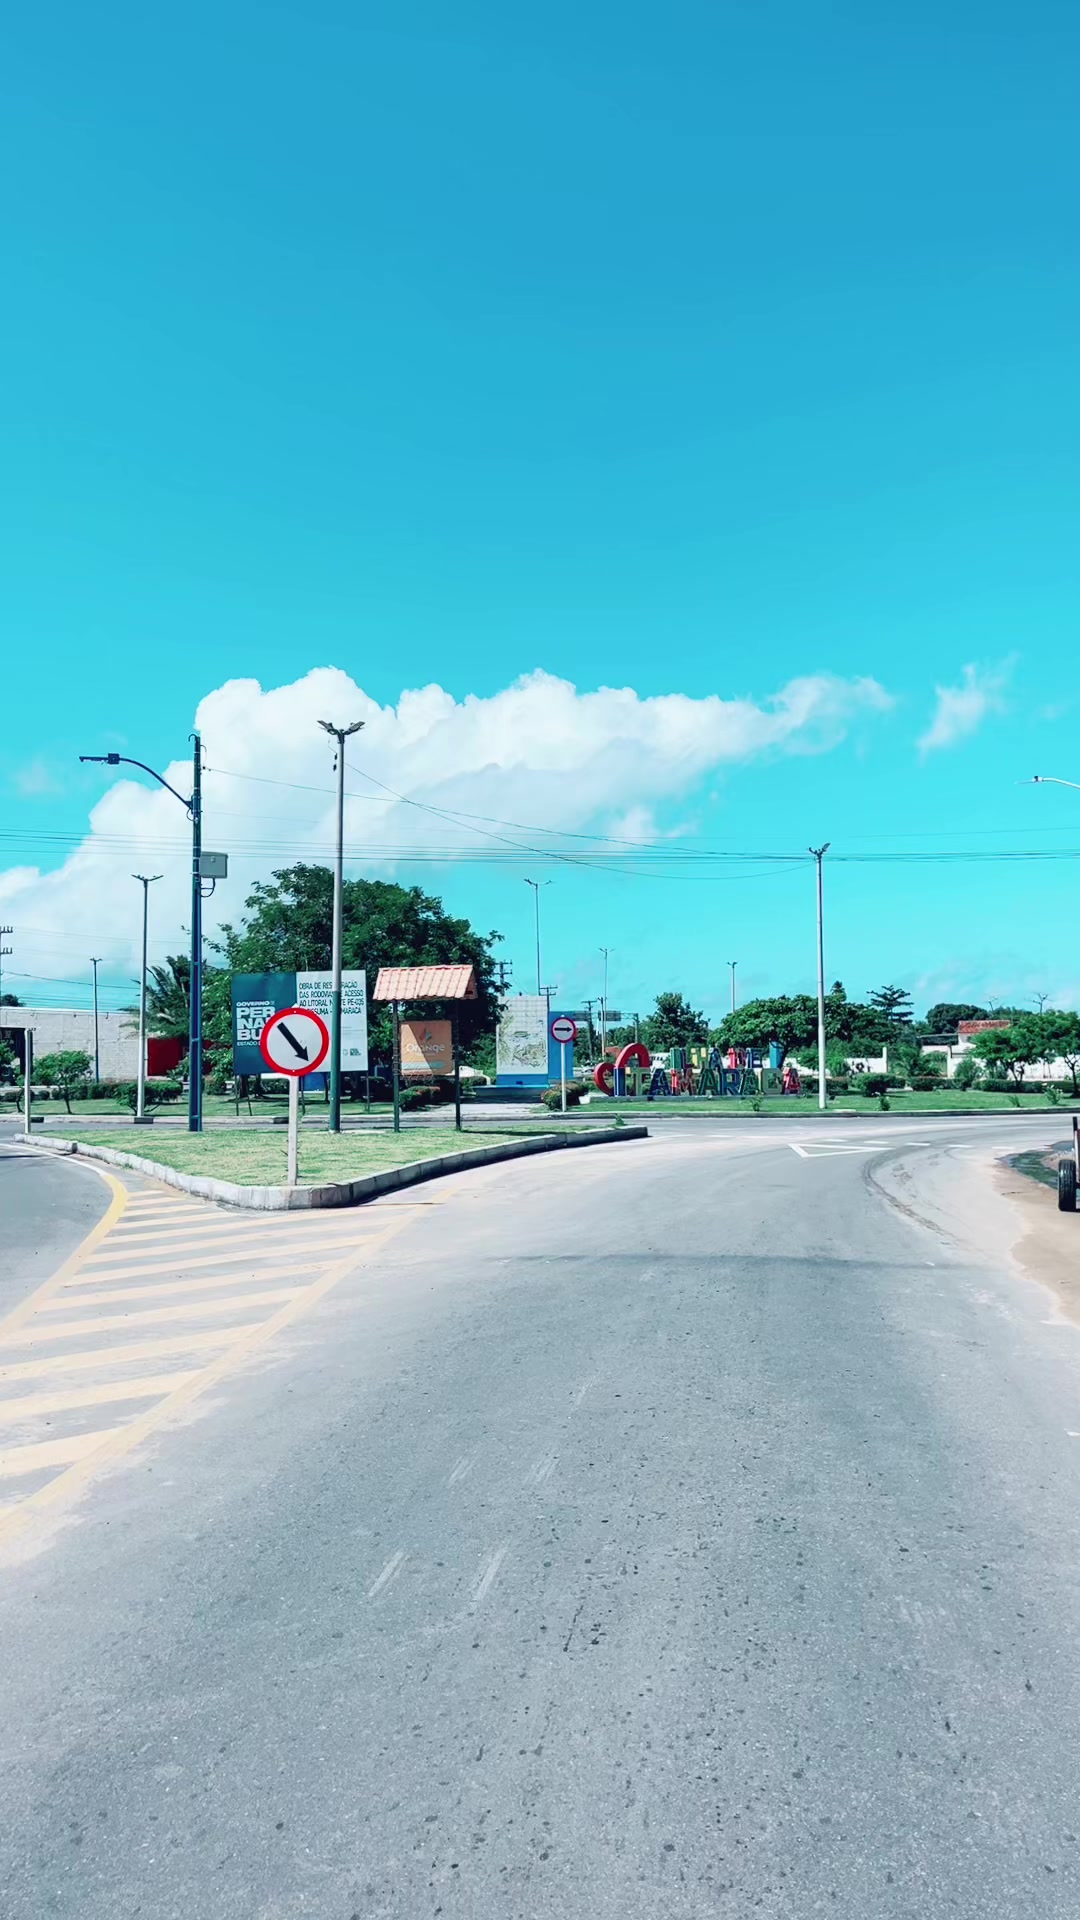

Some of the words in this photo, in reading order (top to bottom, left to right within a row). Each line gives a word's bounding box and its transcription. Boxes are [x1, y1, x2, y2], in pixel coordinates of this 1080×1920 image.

[344, 989, 364, 997] ACESSO
[308, 999, 328, 1007] LITORAL
[236, 1006, 276, 1018] PER
